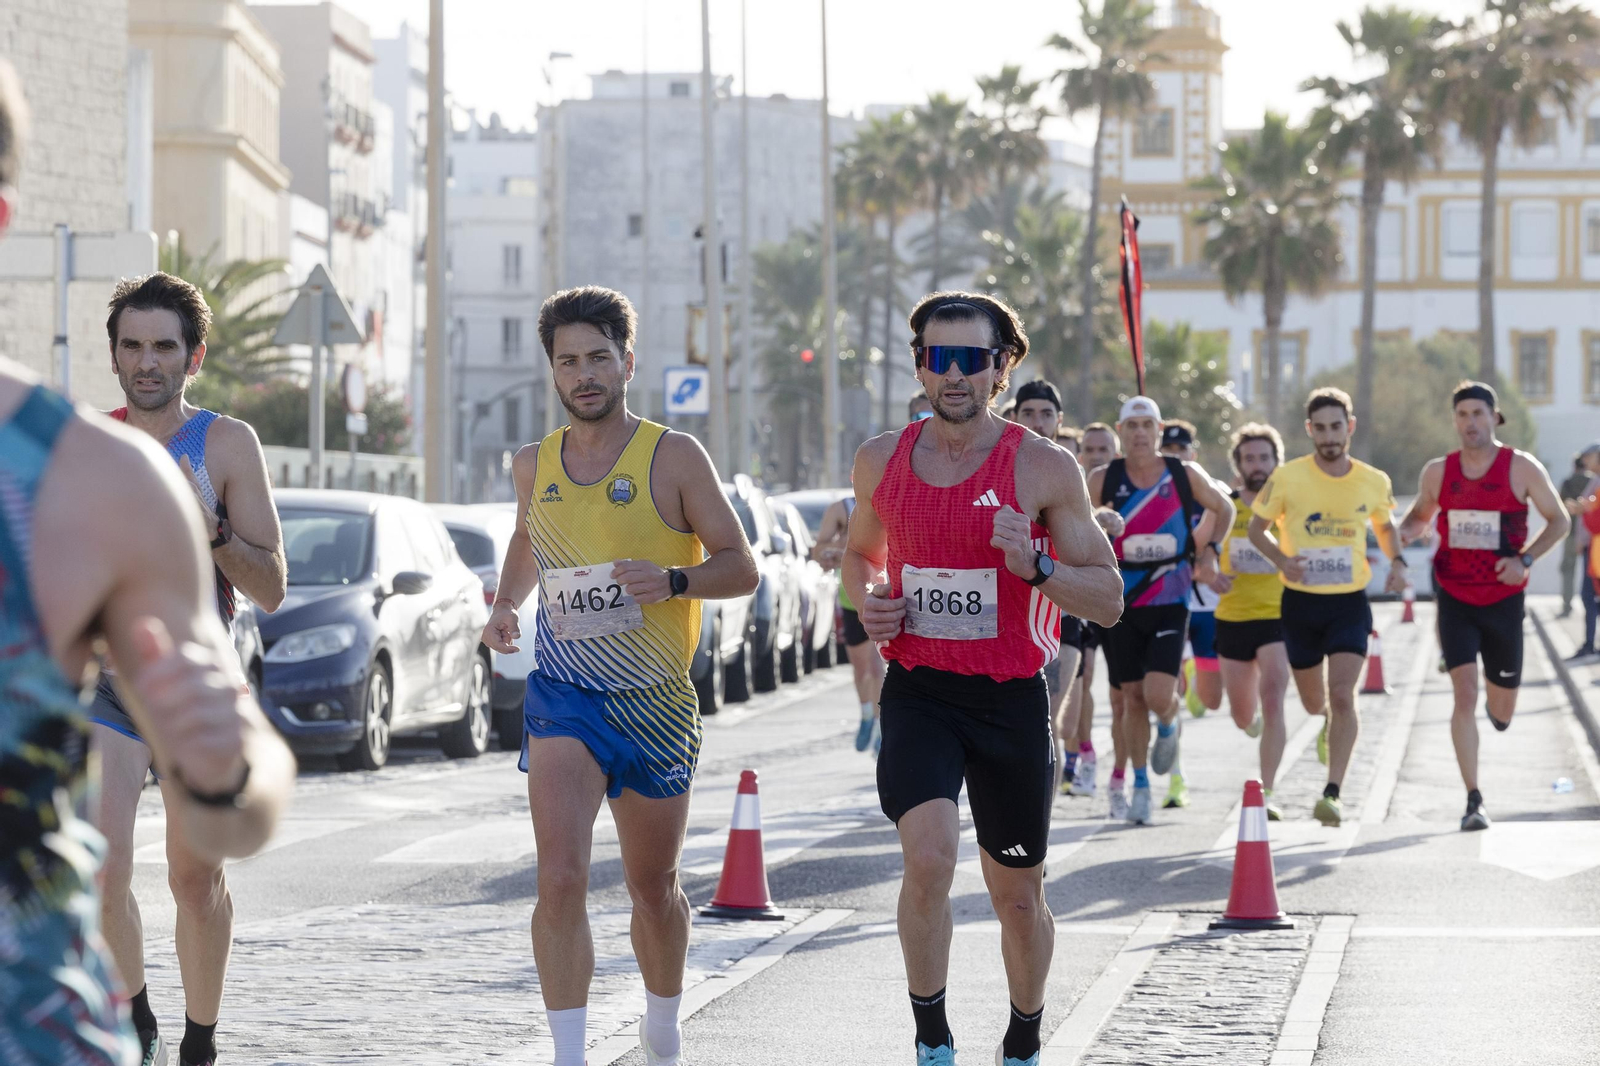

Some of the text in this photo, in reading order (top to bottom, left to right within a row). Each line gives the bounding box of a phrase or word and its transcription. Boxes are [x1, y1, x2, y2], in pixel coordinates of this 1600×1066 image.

[1308, 557, 1346, 573] 1386
[557, 584, 625, 615] 1462
[913, 587, 982, 616] 1868
